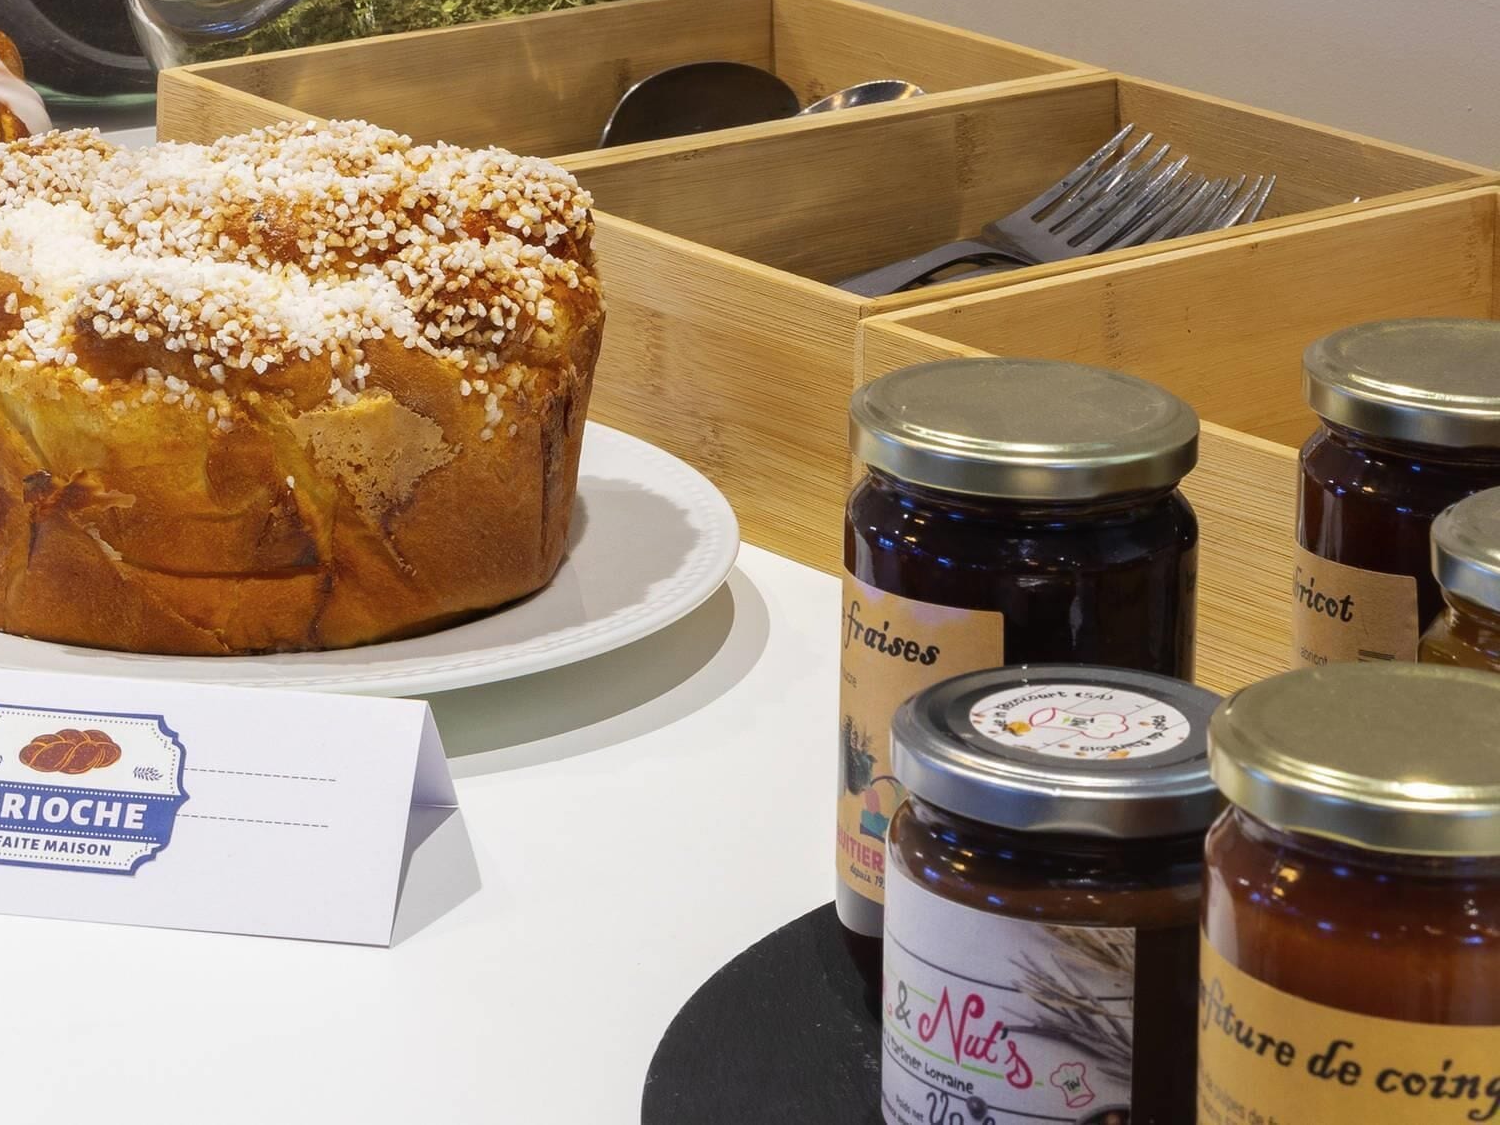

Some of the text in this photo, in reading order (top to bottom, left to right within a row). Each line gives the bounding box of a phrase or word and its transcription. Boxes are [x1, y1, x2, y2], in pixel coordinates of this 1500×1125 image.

[844, 600, 941, 665] fraises
[42, 838, 112, 857] MAISON
[894, 979, 912, 1030] &
[917, 985, 1035, 1090] Nut's
[924, 1062, 975, 1095] Lorraine
[1306, 1039, 1362, 1086] de
